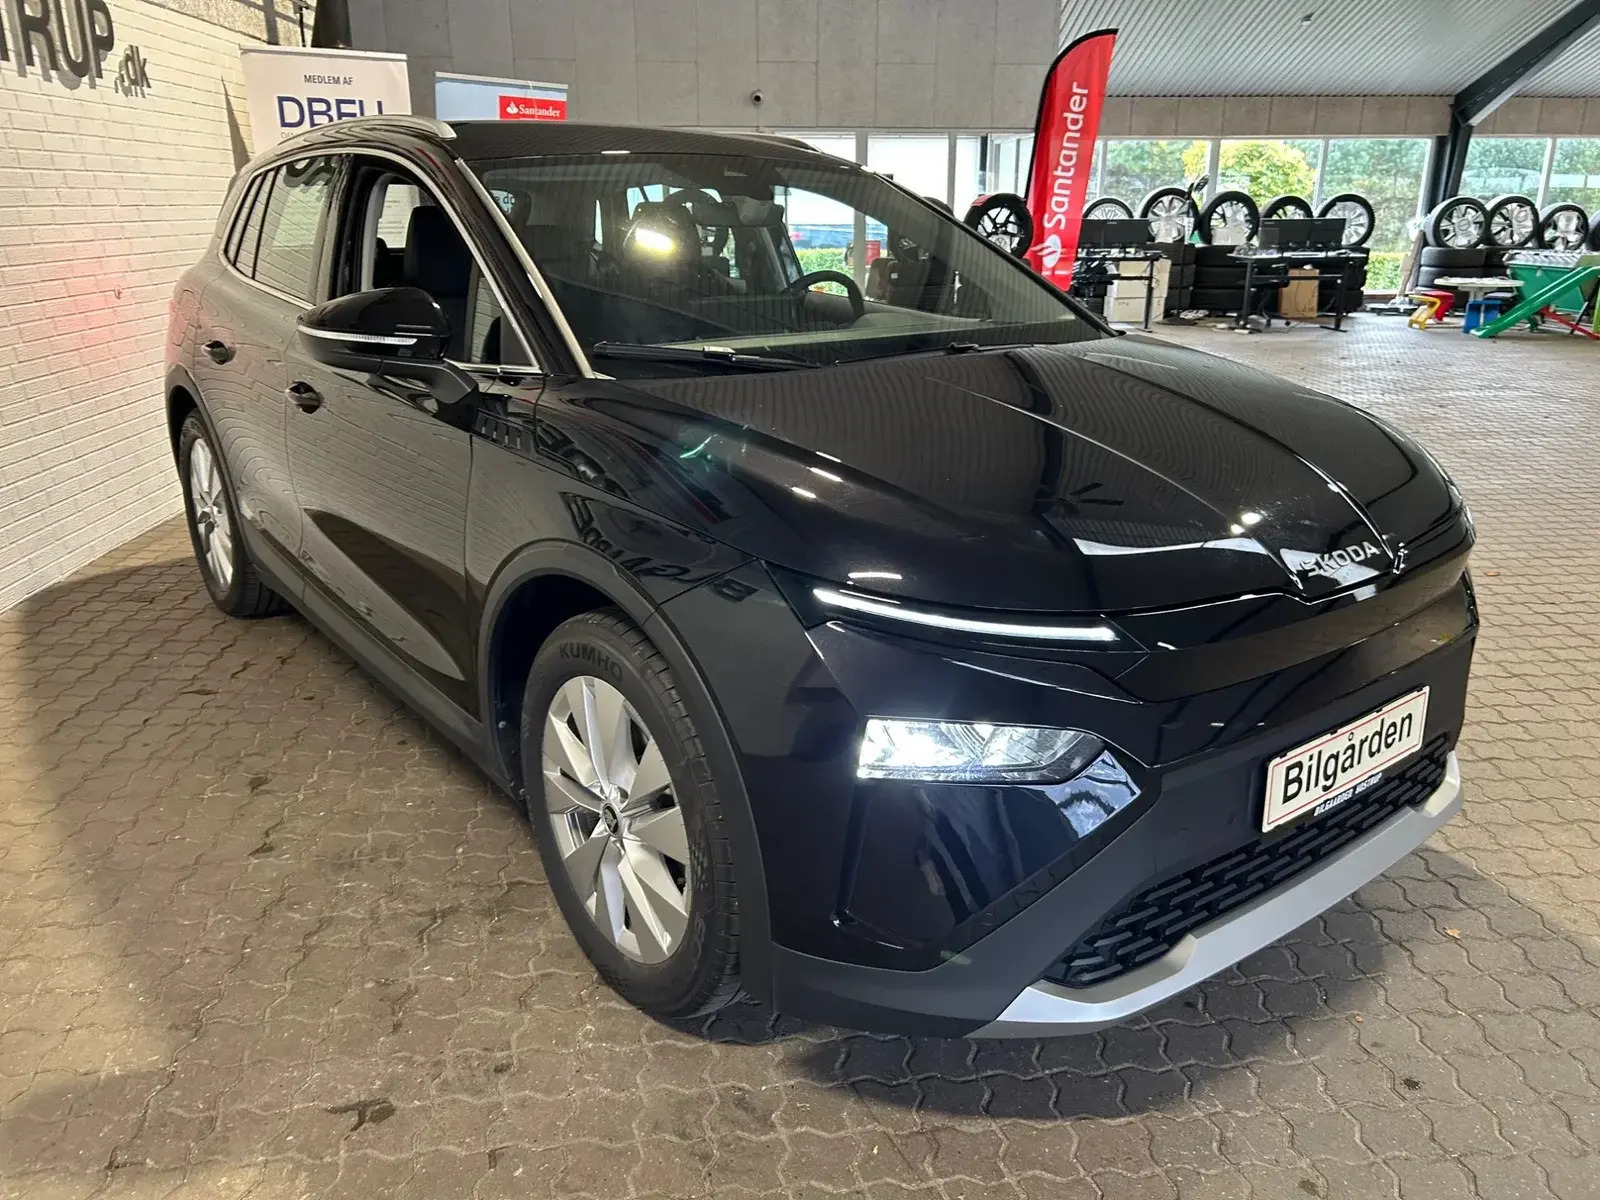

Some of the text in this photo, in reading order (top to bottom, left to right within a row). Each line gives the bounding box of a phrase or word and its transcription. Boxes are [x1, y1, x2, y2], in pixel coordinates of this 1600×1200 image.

[303, 73, 354, 86] MEDLEM AF
[518, 104, 561, 117] Santander
[1043, 81, 1089, 231] Santander
[559, 641, 622, 681] KUMHO
[1281, 711, 1414, 805] Bilgården
